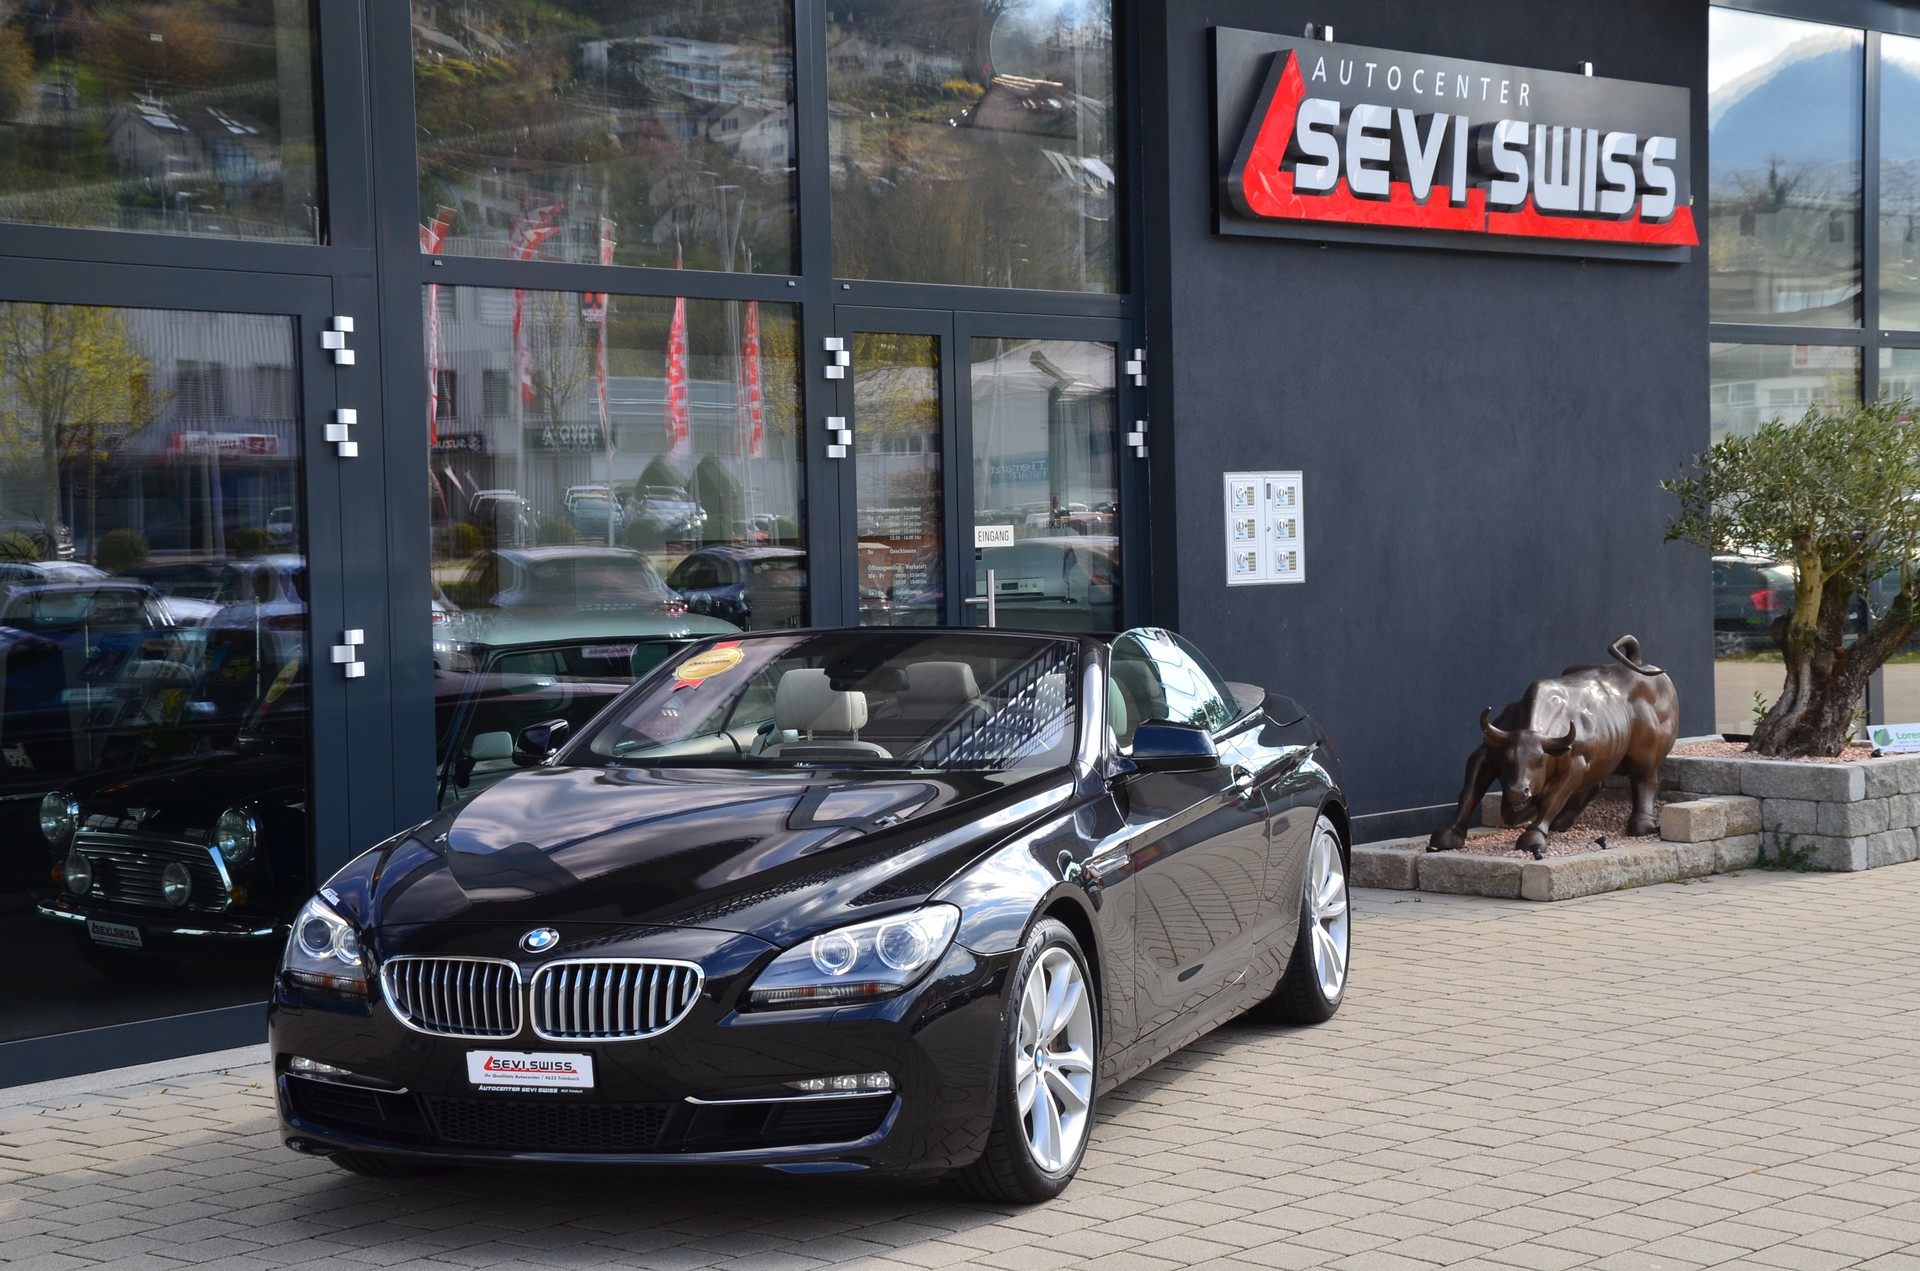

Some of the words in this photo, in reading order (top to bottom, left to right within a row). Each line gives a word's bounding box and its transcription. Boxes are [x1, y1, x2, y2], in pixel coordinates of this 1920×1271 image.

[1311, 56, 1530, 107] AUTOCENTER
[1293, 98, 1469, 202] SEVI
[1490, 119, 1677, 218] SWISS
[978, 530, 1010, 542] EINGANG
[492, 1059, 526, 1070] SEVI
[529, 1061, 573, 1071] SWISS
